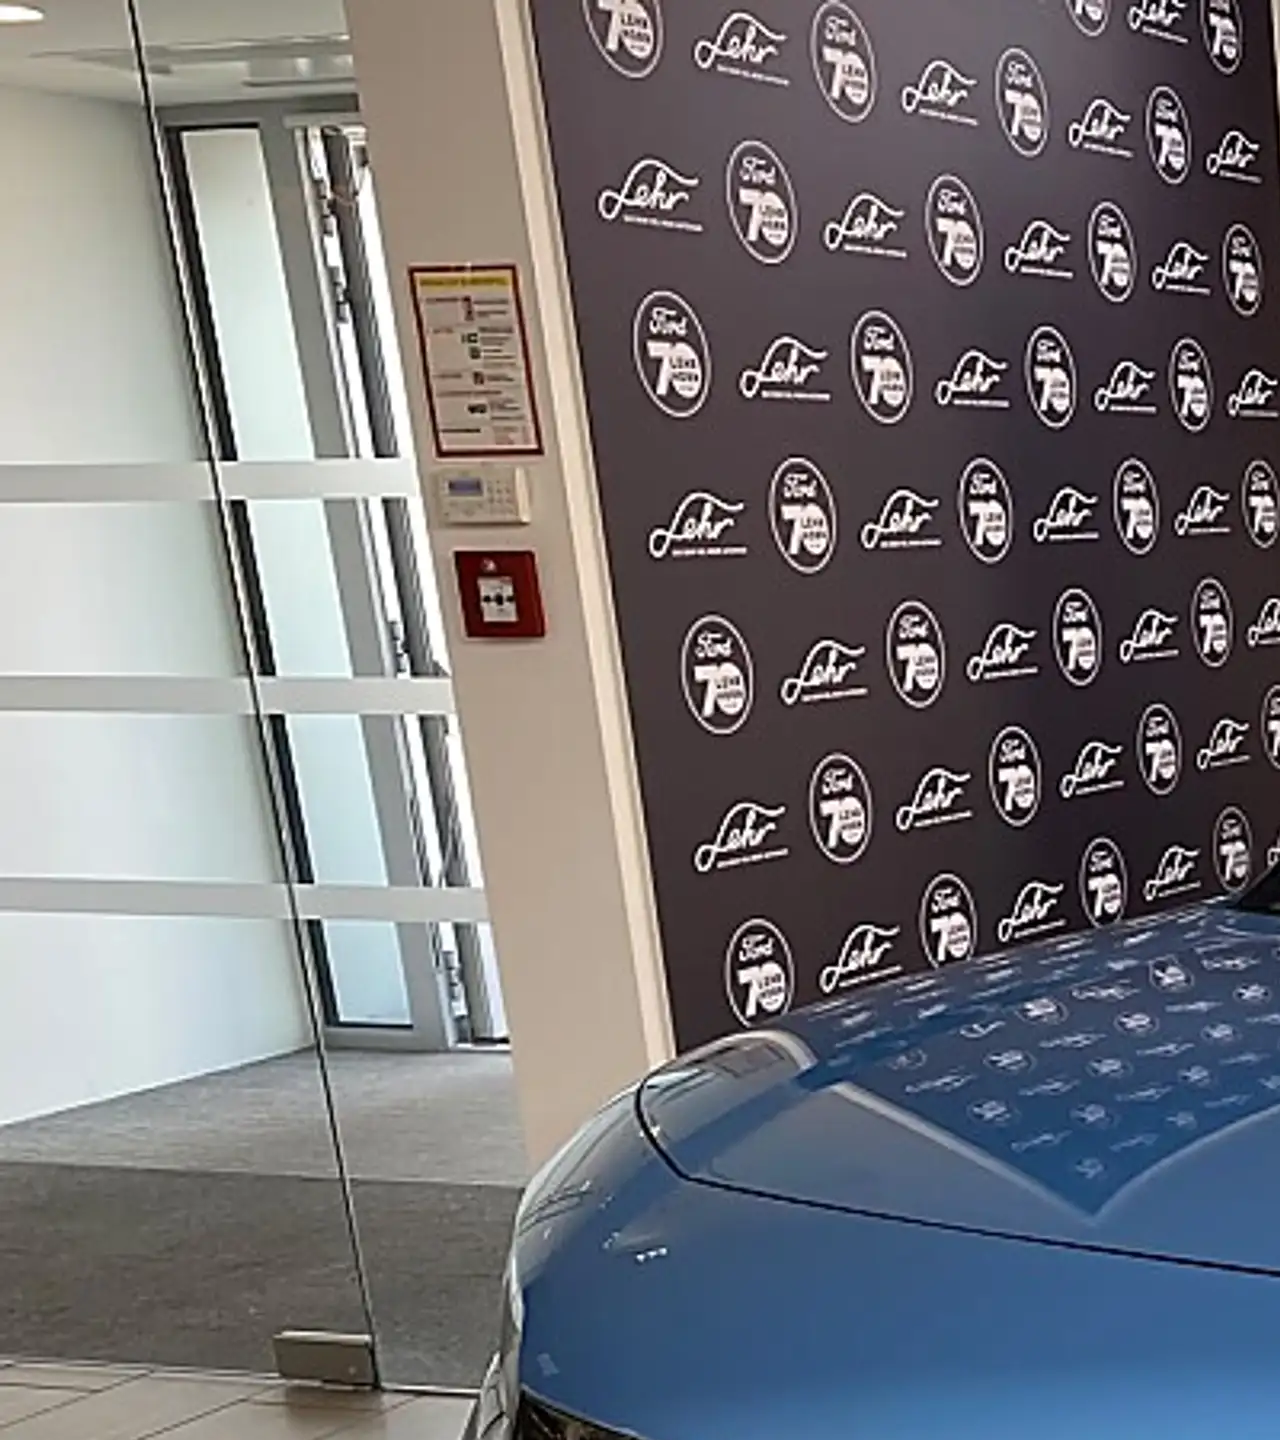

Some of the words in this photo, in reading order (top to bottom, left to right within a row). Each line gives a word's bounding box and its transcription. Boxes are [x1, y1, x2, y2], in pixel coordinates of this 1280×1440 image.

[598, 0, 653, 58] 70
[695, 13, 786, 68] Lehr
[825, 16, 855, 45] Ford
[823, 46, 868, 104] 70
[902, 61, 976, 112] Lehr
[1005, 89, 1042, 142] 70
[599, 160, 698, 220] Lehr
[740, 157, 775, 185] Ford
[740, 188, 788, 245] 70
[825, 194, 904, 250] Lehr
[938, 189, 966, 215] Ford
[936, 218, 976, 270] 70
[1005, 221, 1070, 272] Lehr
[650, 307, 687, 336] Ford
[864, 326, 894, 350] Ford
[647, 340, 701, 398] 70
[740, 337, 827, 398] Lehr
[861, 356, 906, 407] 70
[935, 350, 1007, 405] Lehr
[1034, 366, 1070, 412] 70
[784, 474, 816, 497] Ford
[650, 493, 744, 557] Lehr
[781, 502, 827, 555] 70
[861, 490, 938, 548] Lehr
[968, 500, 1006, 545] 70
[1034, 487, 1098, 542] Lehr
[695, 631, 732, 658] Ford
[899, 615, 928, 638] Ford
[967, 624, 1037, 681] Lehr
[694, 662, 747, 717] 70
[781, 640, 865, 705] Lehr
[896, 642, 938, 693] 70
[822, 769, 853, 794] Ford
[999, 765, 1035, 811] 70
[1060, 742, 1122, 798] Lehr
[820, 797, 865, 849] 70
[896, 768, 970, 830] Lehr
[695, 803, 785, 872] Lehr
[932, 888, 960, 913] Ford
[998, 881, 1063, 942] Lehr
[739, 935, 773, 961] Ford
[820, 925, 900, 993] Lehr
[931, 912, 969, 961] 70
[737, 962, 785, 1017] 70
